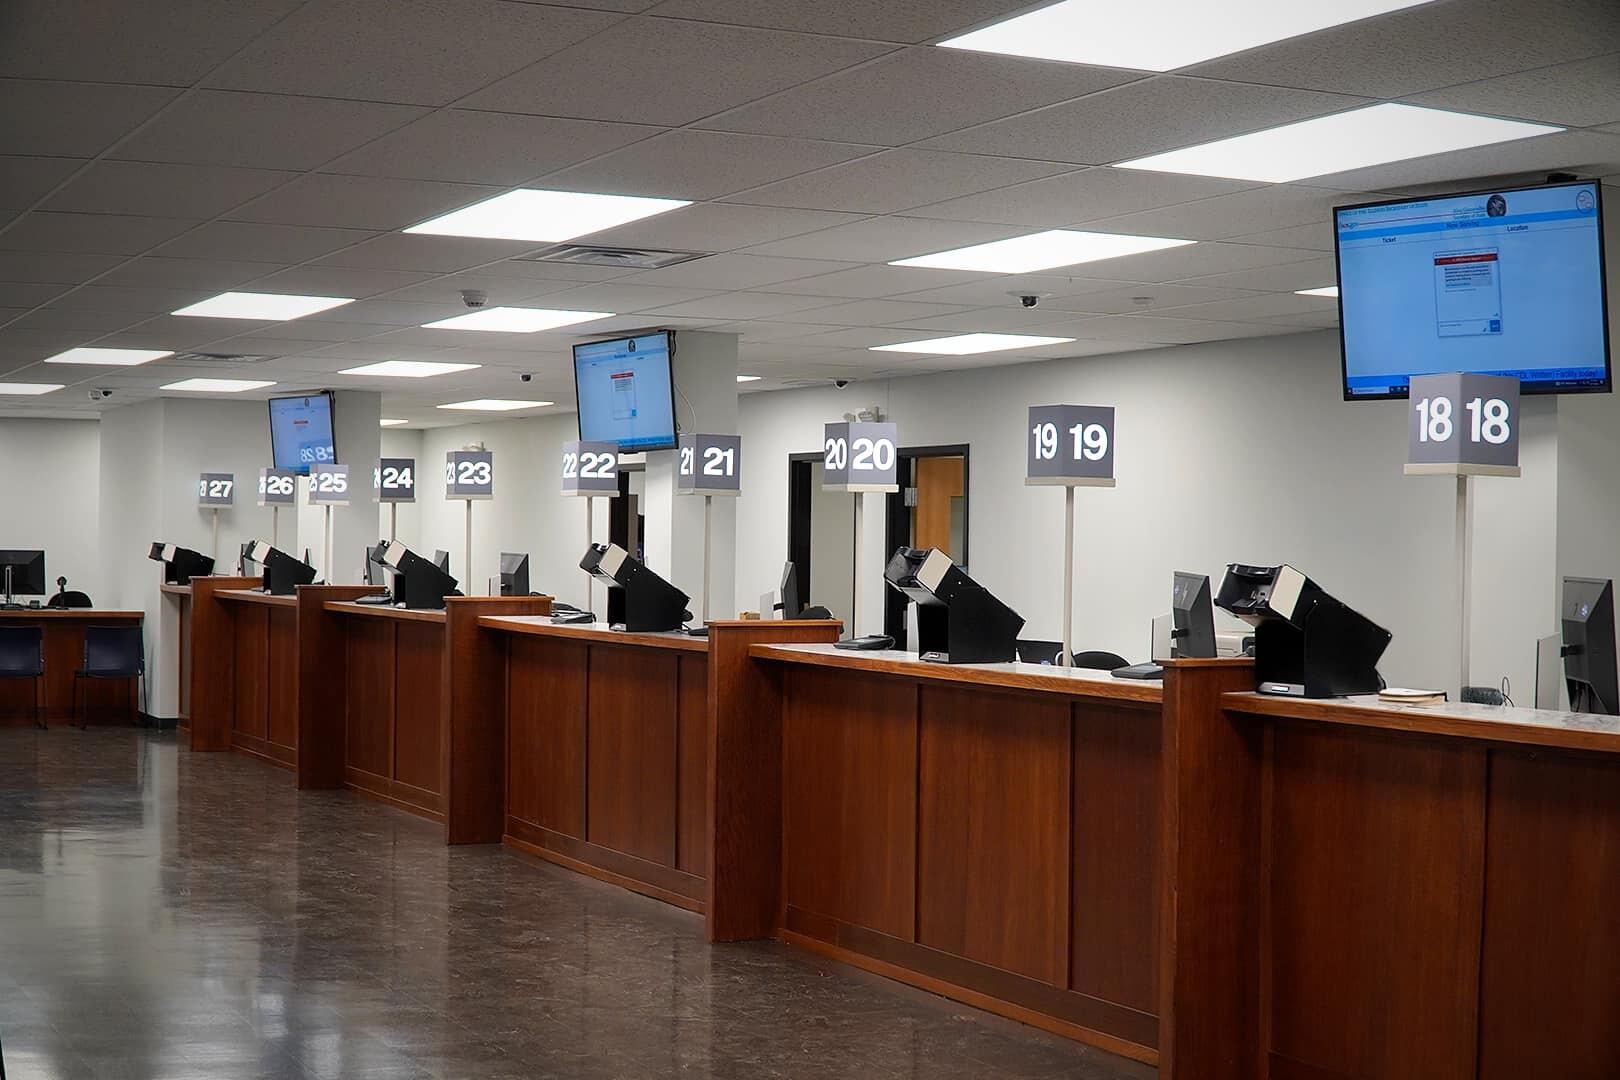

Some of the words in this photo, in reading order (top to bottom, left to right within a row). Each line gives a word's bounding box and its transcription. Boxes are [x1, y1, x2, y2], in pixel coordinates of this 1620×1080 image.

[1507, 225, 1529, 233] Location
[1416, 397, 1453, 442] 18
[1466, 398, 1510, 444] 18
[825, 438, 847, 470] 20
[852, 438, 895, 470] 20
[1033, 423, 1058, 460] 19
[1069, 424, 1108, 460] 19
[458, 462, 491, 485] 23
[563, 453, 577, 478] 22
[580, 452, 616, 478] 22
[680, 447, 694, 475] 21
[703, 447, 734, 476] 21
[209, 480, 233, 498] 27
[267, 476, 294, 495] 26
[319, 472, 347, 493] 25
[382, 467, 413, 489] 24
